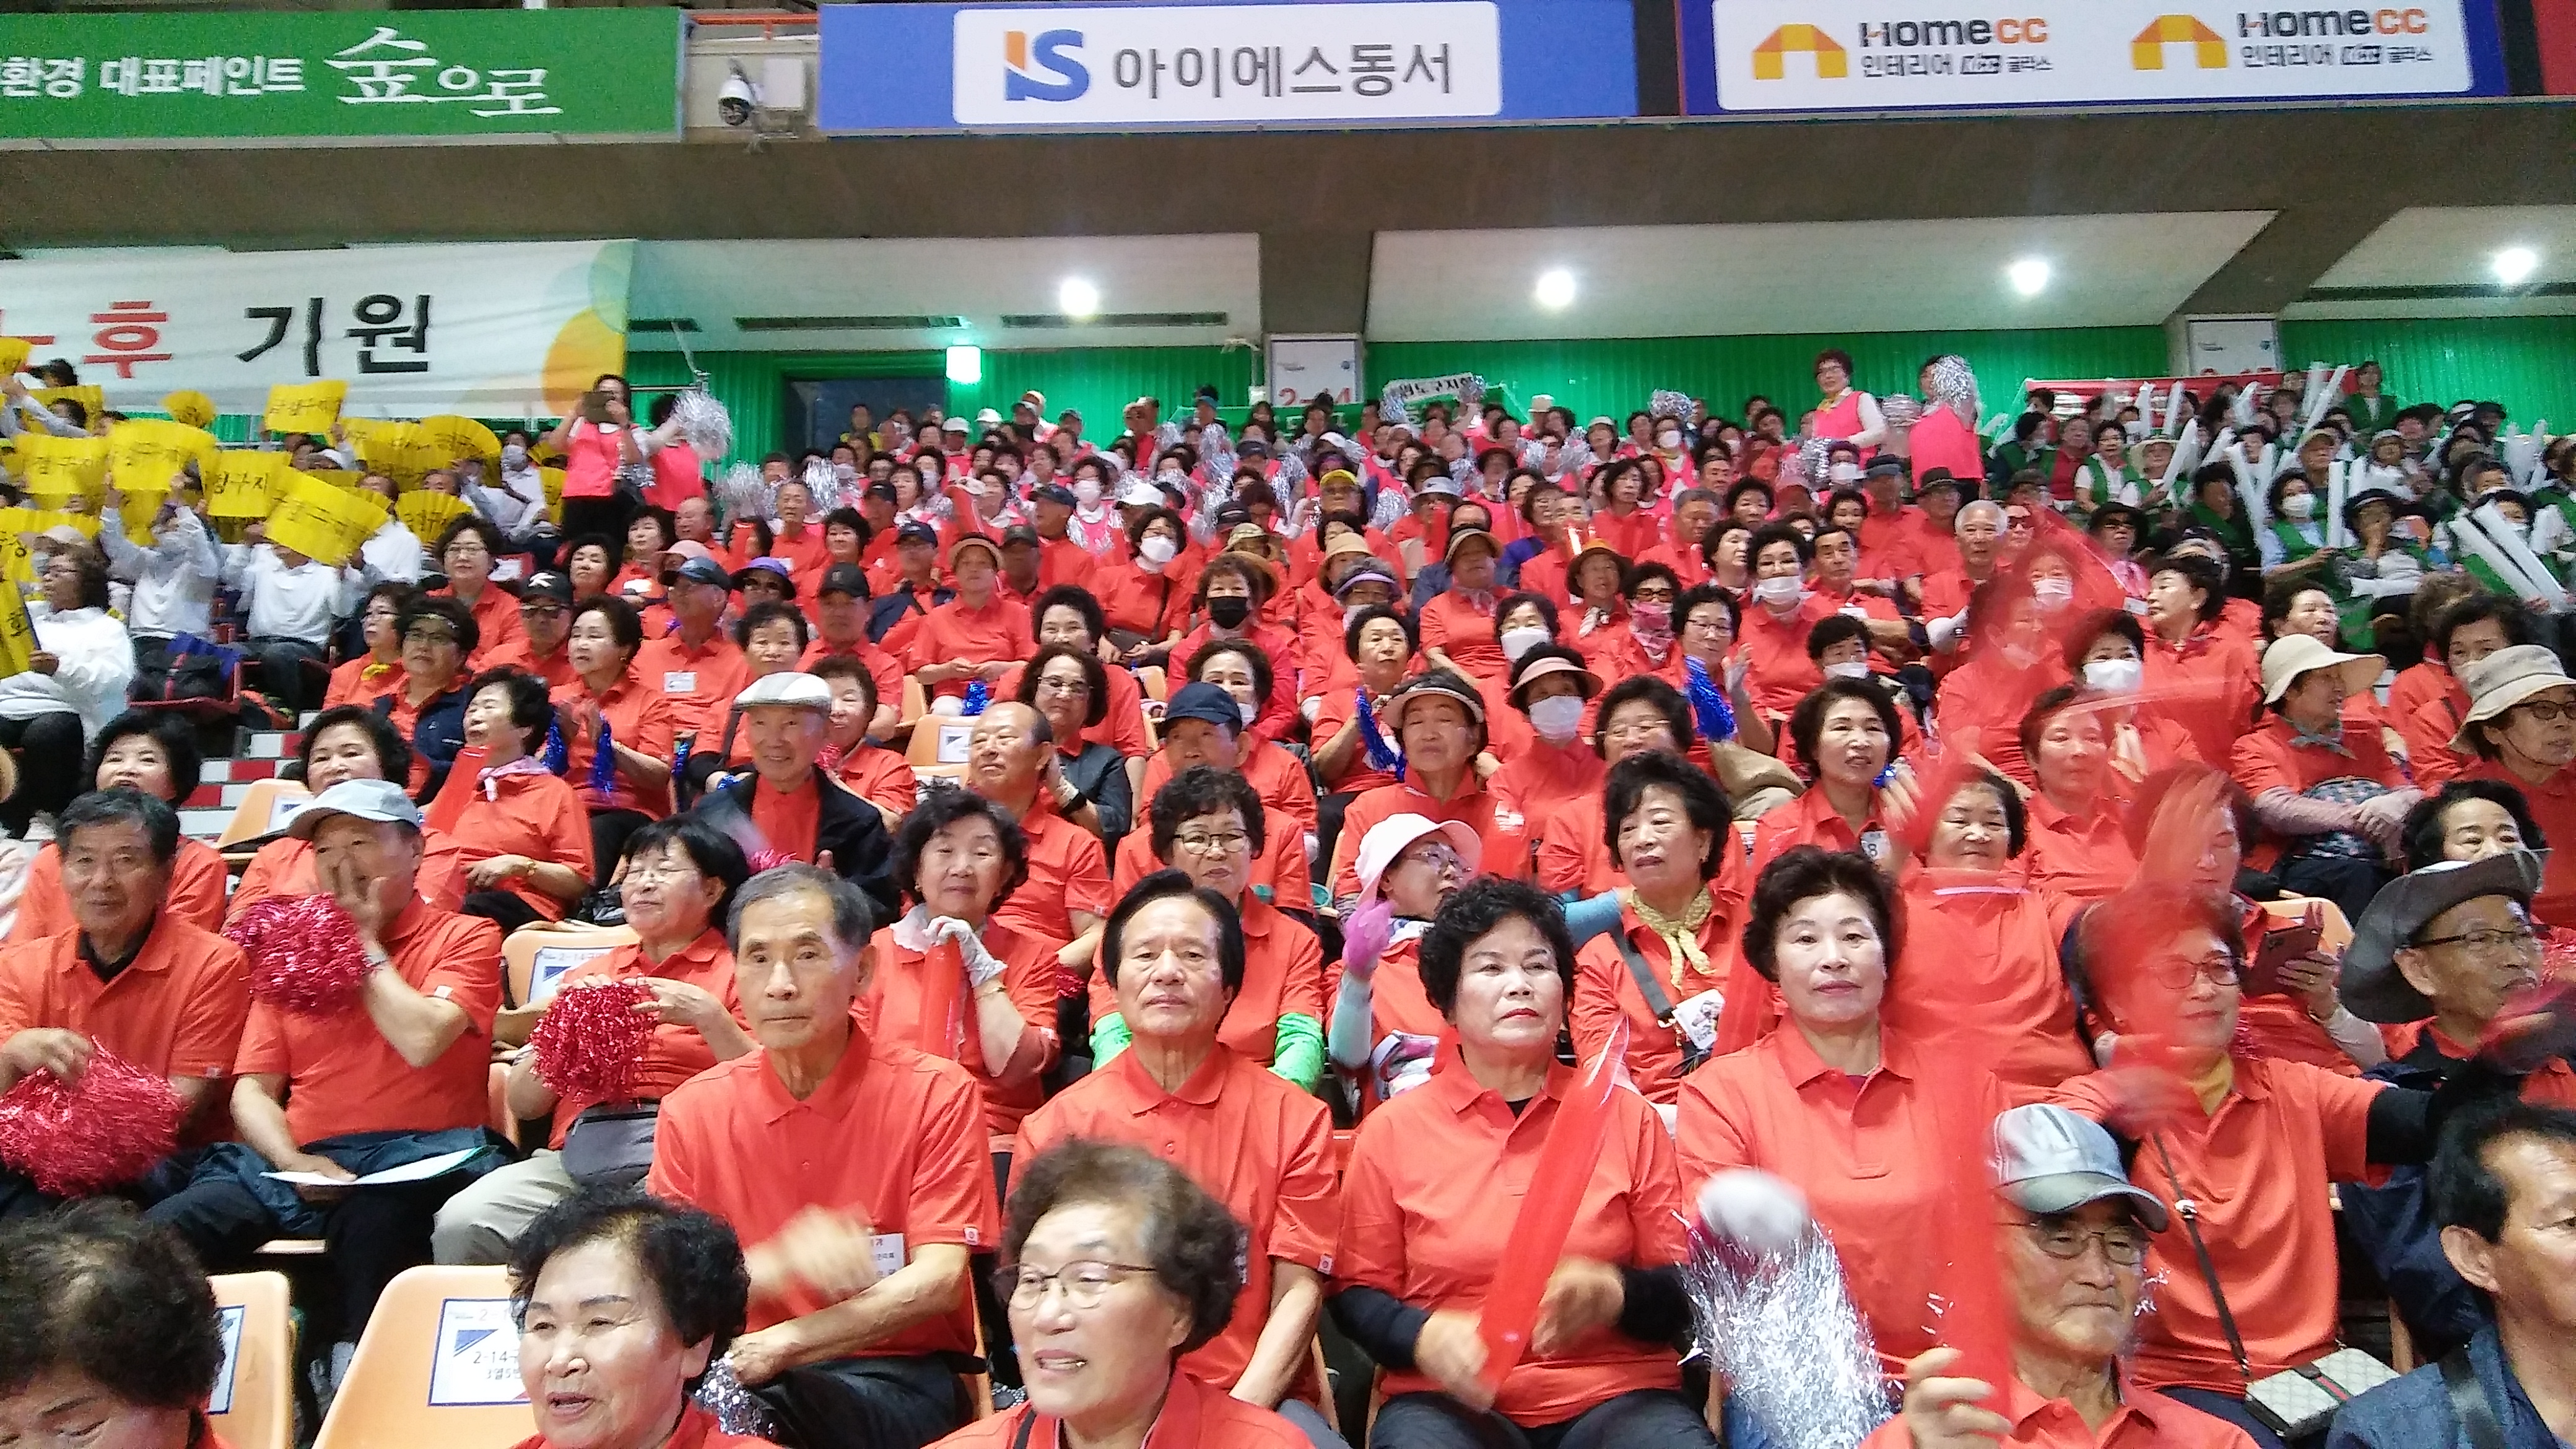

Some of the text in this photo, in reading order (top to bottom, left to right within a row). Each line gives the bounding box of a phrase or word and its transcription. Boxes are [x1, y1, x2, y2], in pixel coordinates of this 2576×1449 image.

[2, 26, 564, 118] 환경 대표페인트 숲으로
[1115, 43, 1454, 99] 아이에스동서
[1860, 54, 1953, 77] 인테리어
[2240, 44, 2333, 67] 인테리어
[235, 294, 432, 376] 기원
